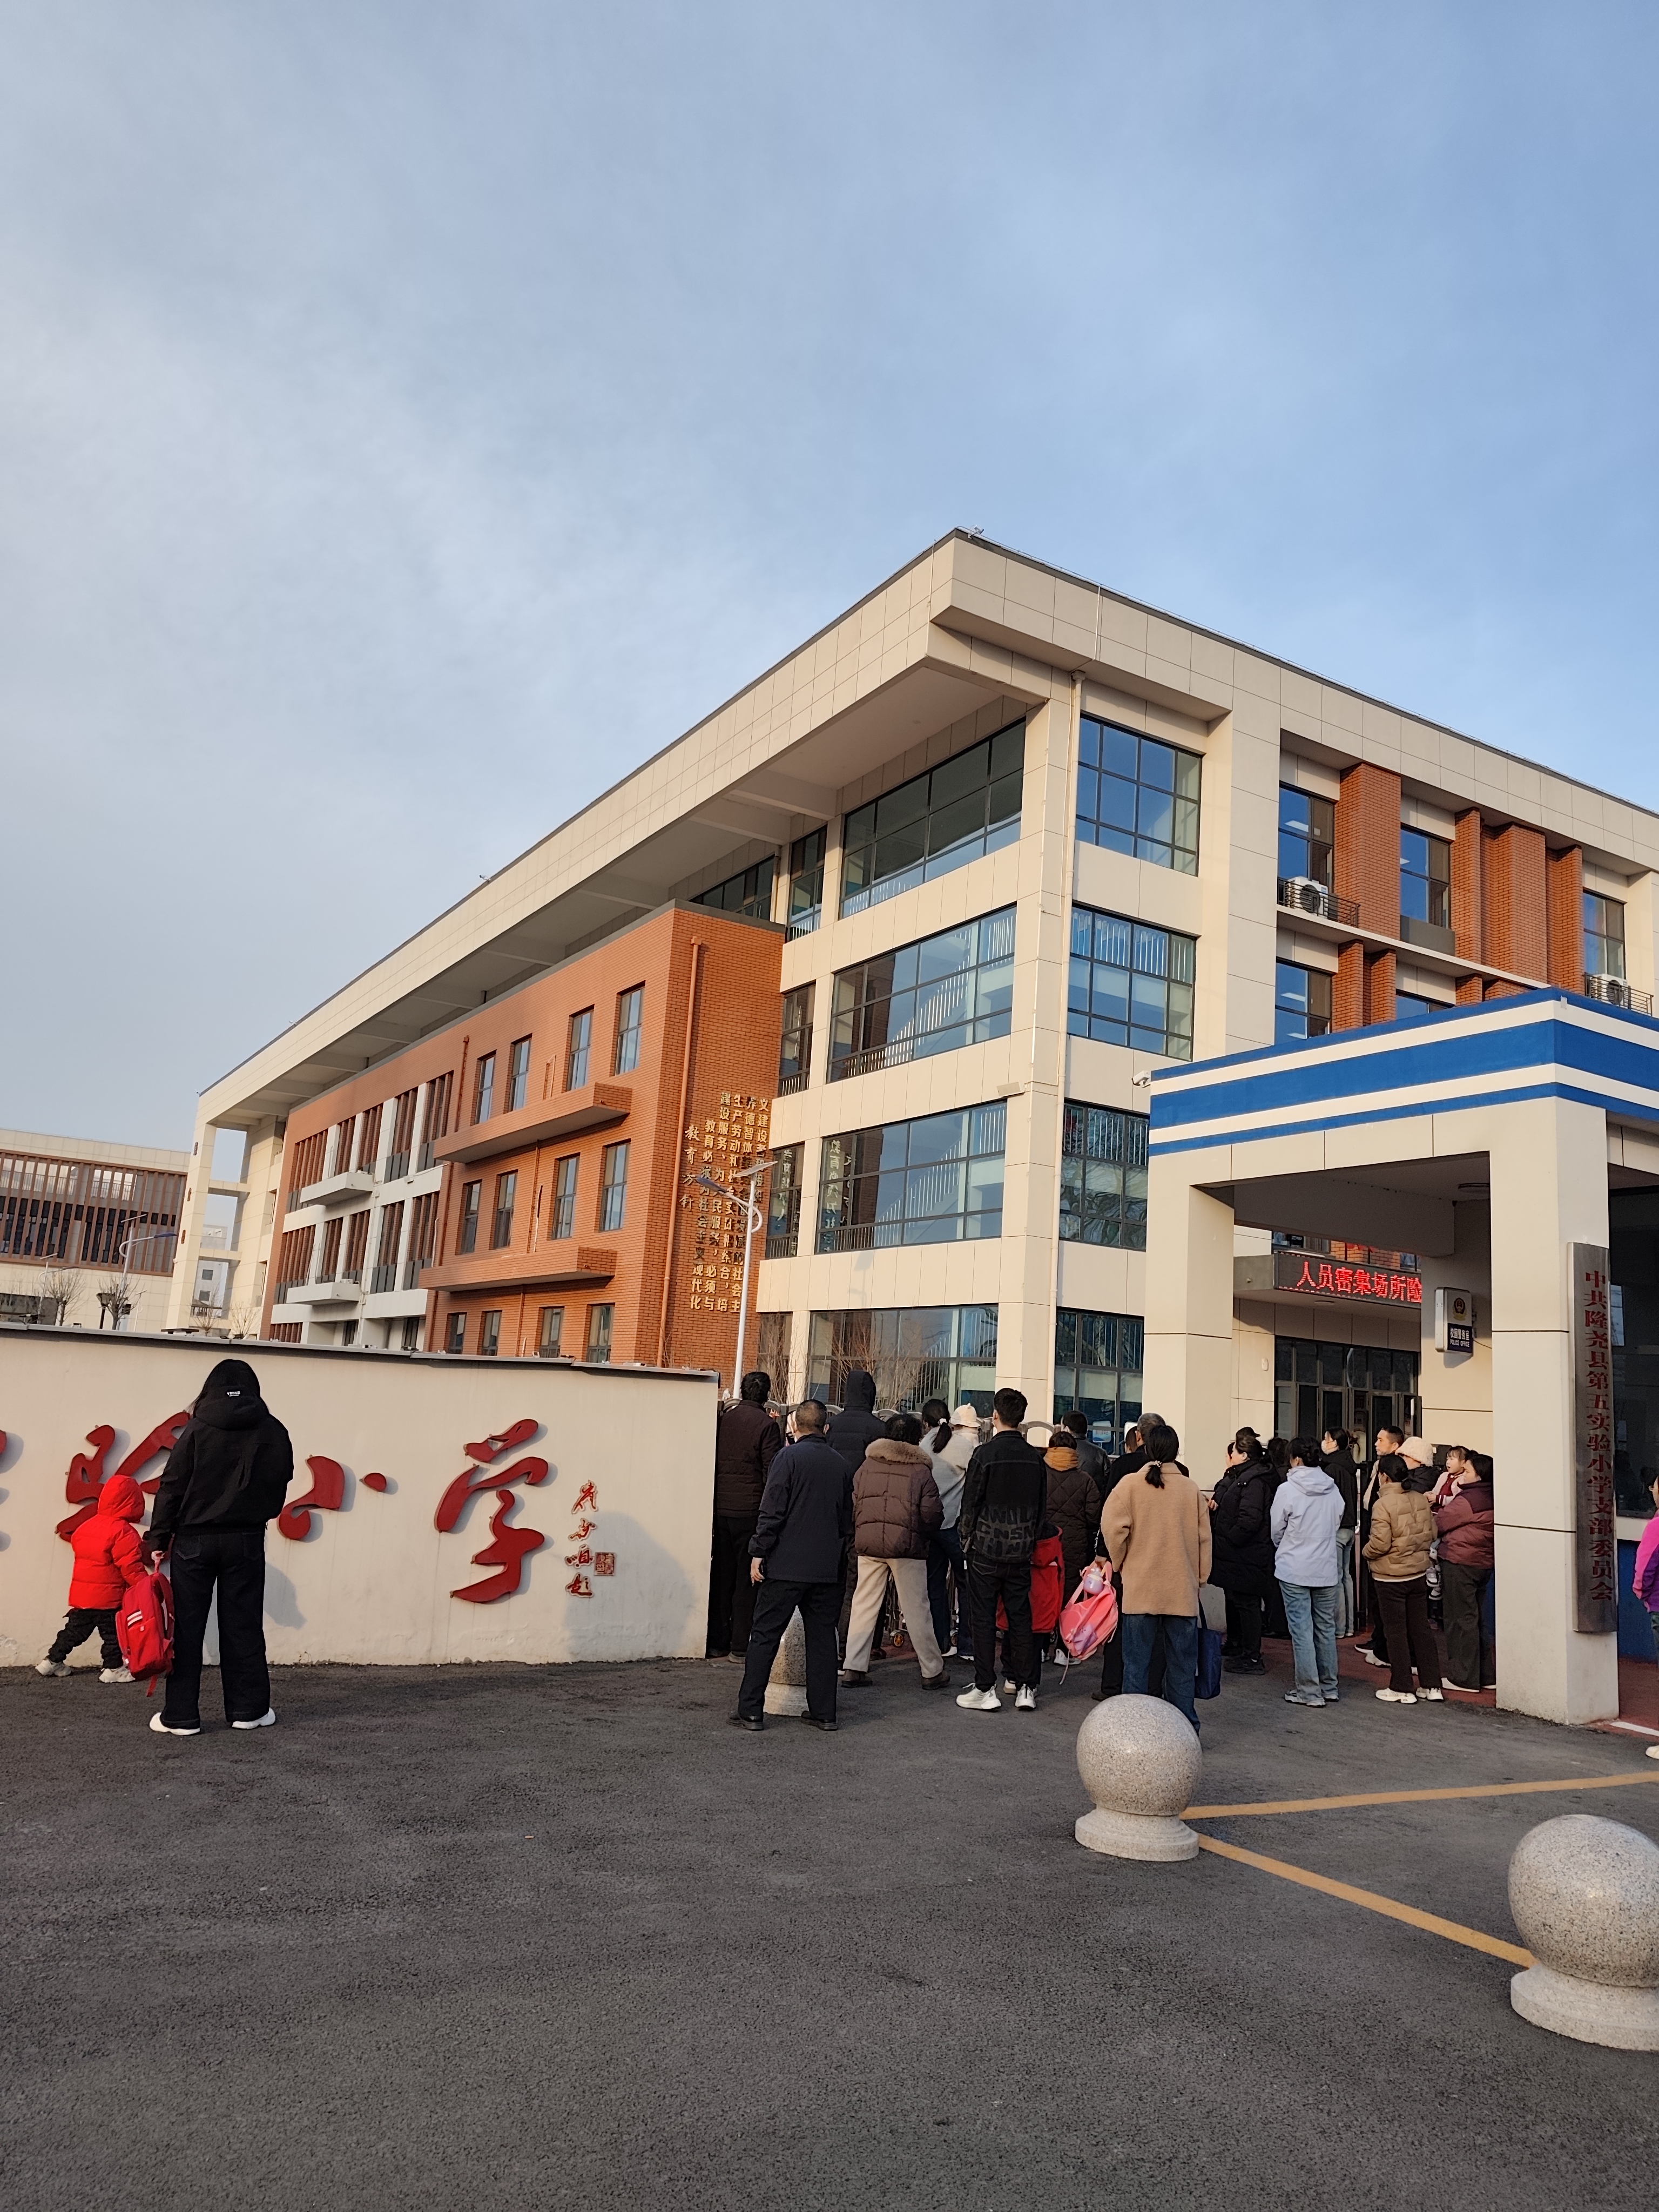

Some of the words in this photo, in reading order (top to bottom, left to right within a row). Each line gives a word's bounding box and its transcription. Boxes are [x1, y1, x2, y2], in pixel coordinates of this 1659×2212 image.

[679, 1124, 700, 1211] 教育方针
[1583, 1270, 1613, 1602] 中共隆尧县第五实验小学支部委员会
